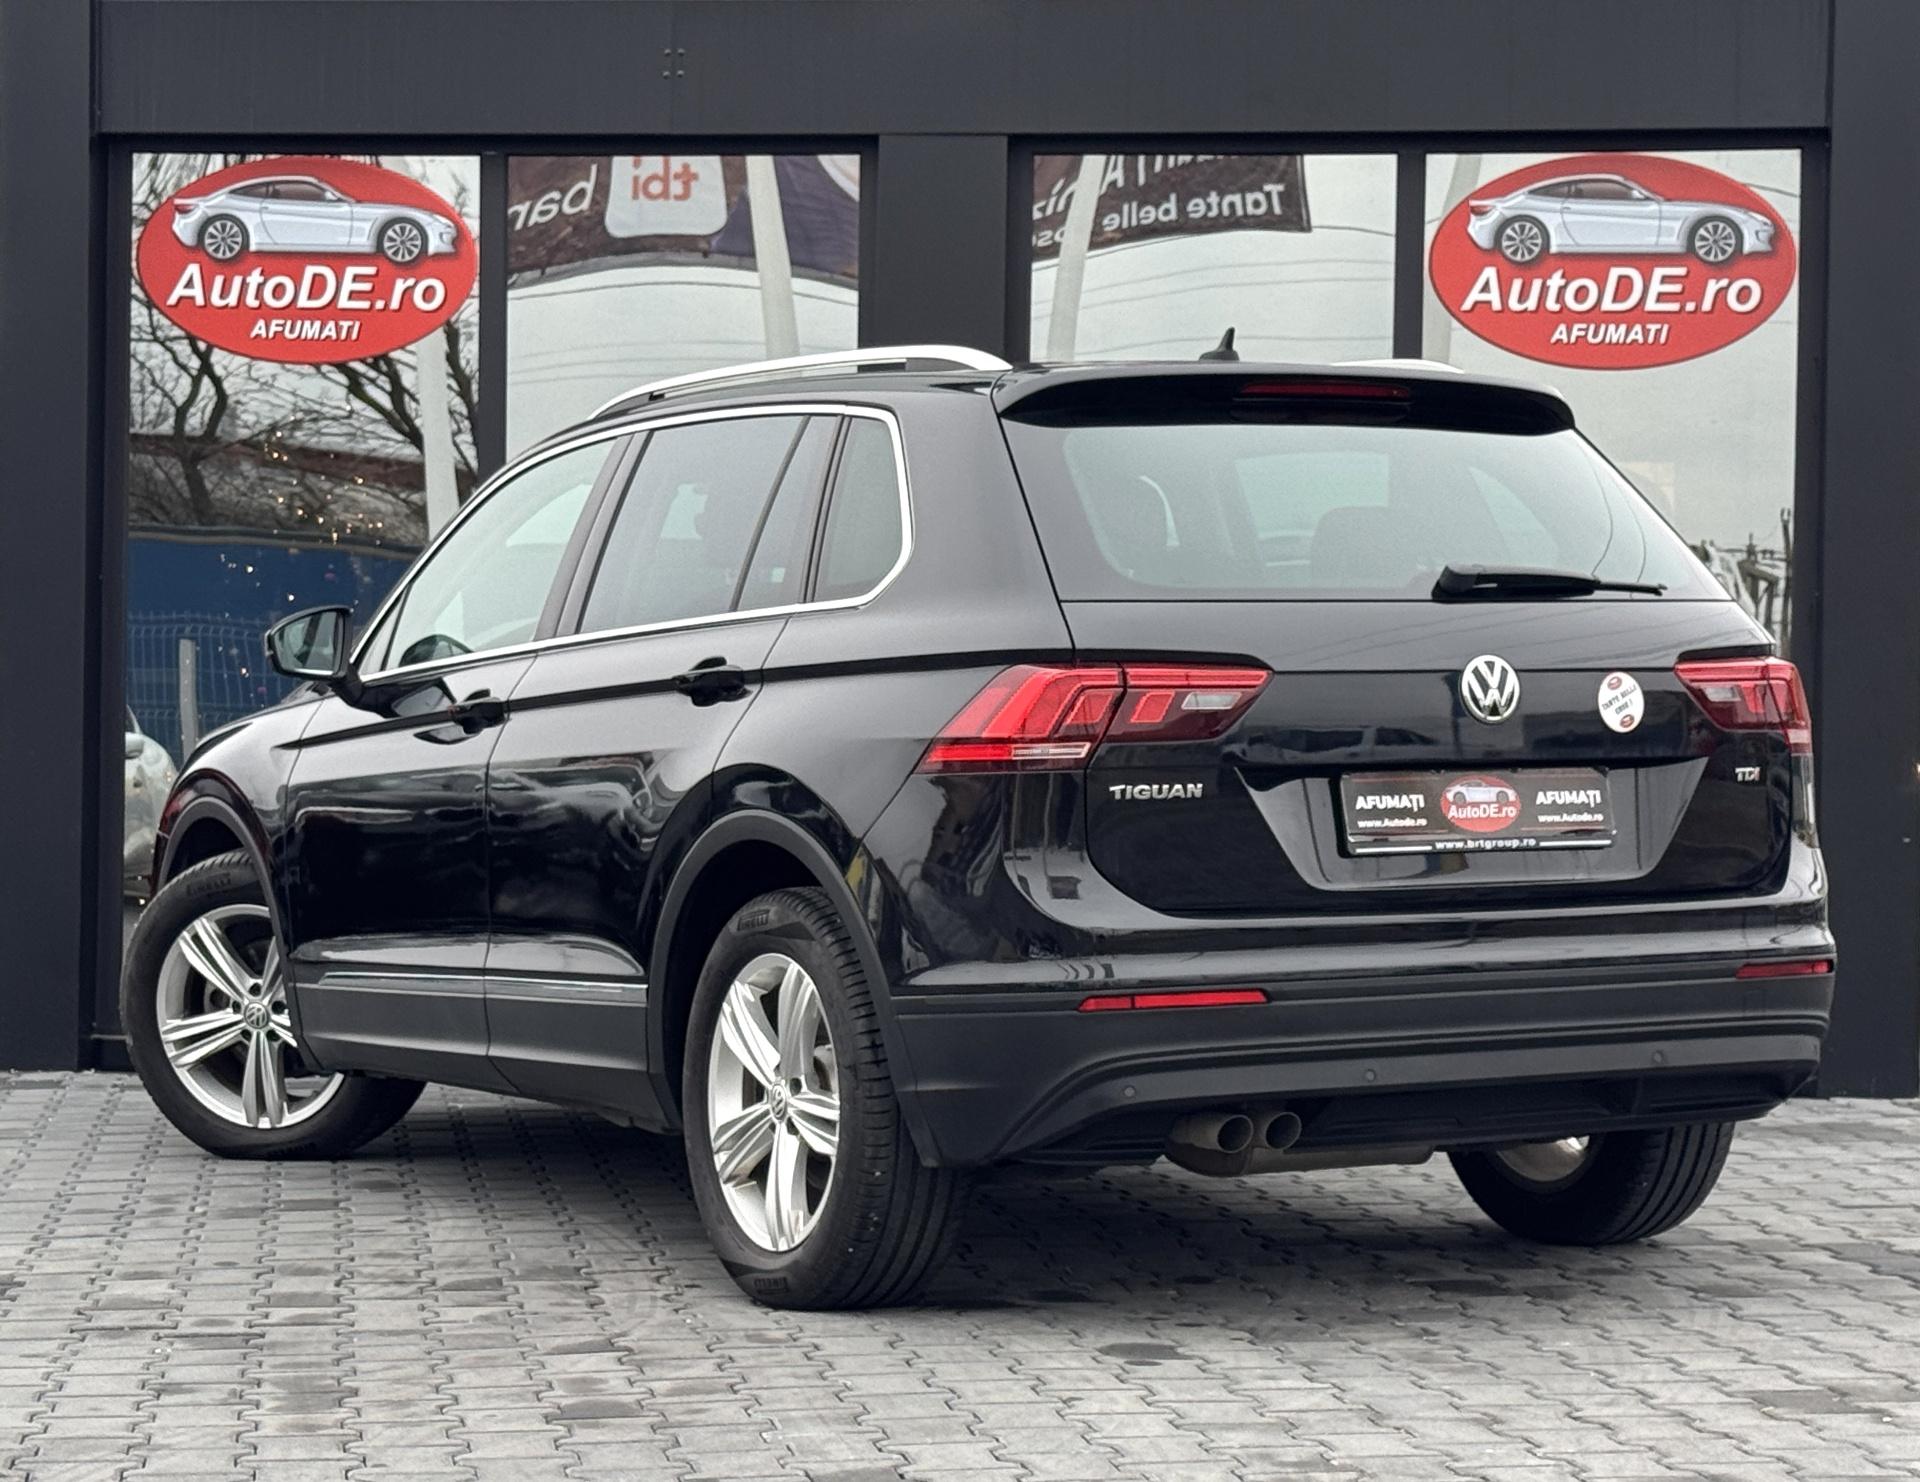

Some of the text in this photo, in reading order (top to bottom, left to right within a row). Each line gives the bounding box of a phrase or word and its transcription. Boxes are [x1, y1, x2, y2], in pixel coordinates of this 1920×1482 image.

[166, 263, 447, 312] AutoDE.ro
[1460, 265, 1763, 314] AutoDE.ro
[250, 318, 361, 341] AFUMATI
[1550, 323, 1669, 345] AFUMATI
[1735, 767, 1760, 782] TDI
[1109, 783, 1203, 800] TIGUAN
[1447, 803, 1517, 820] AutoDE.ro
